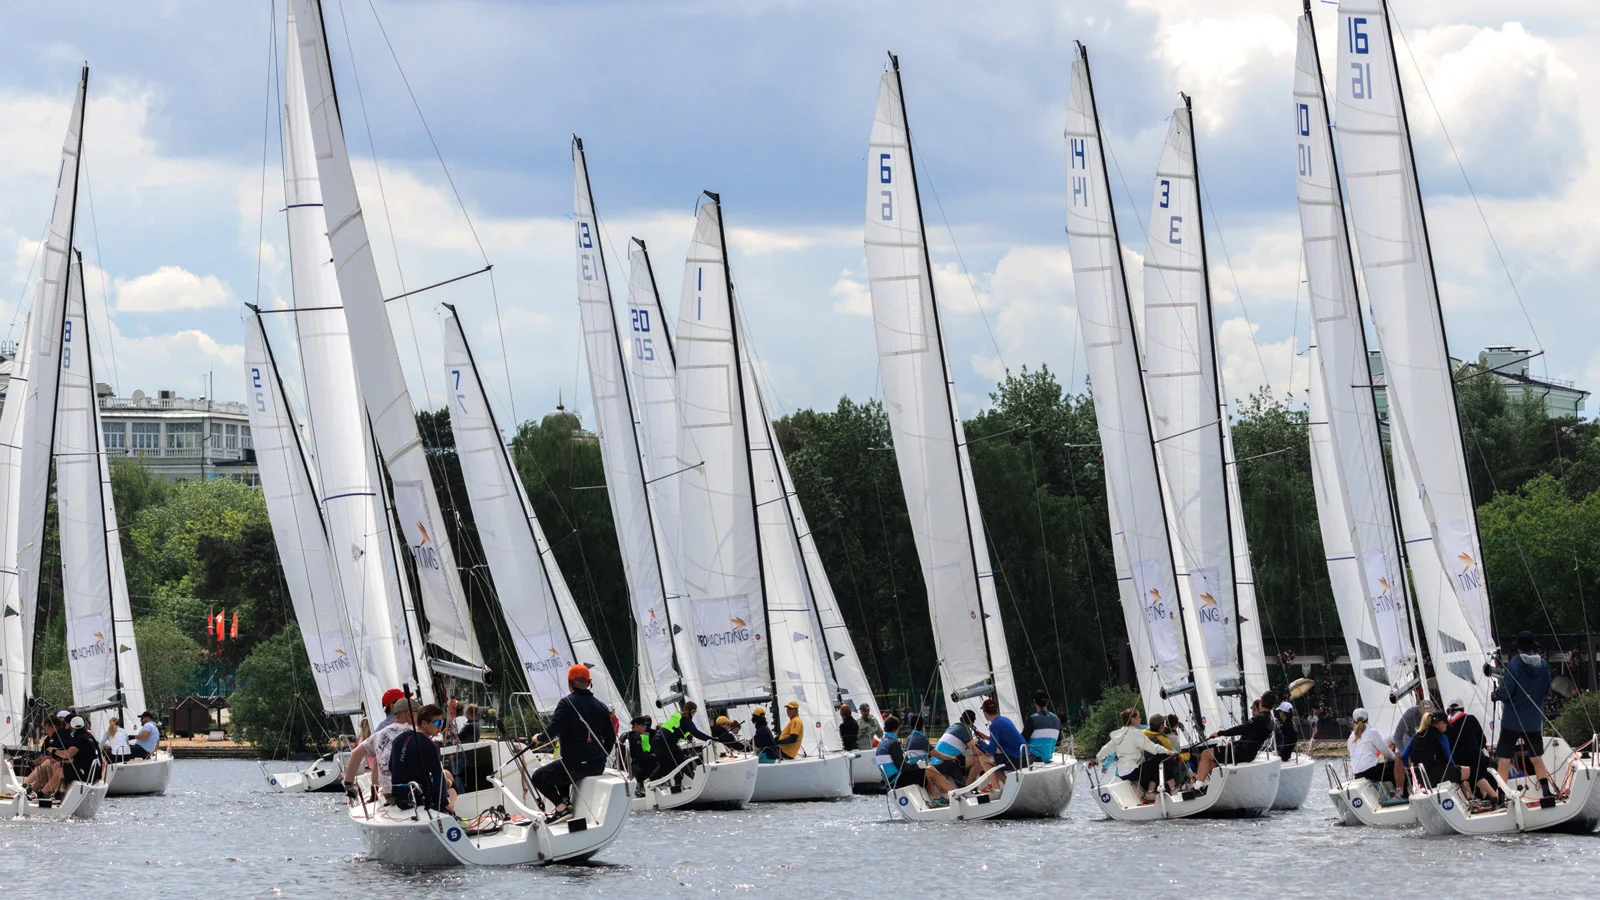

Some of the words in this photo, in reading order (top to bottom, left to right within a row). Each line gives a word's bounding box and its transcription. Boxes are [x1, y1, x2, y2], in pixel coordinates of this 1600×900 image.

[1348, 17, 1369, 54] 16
[1296, 102, 1310, 136] 10
[1070, 138, 1085, 169] 14
[880, 153, 892, 184] 6
[1160, 180, 1170, 208] 3
[577, 221, 593, 249] 13
[64, 320, 72, 343] 8
[631, 309, 651, 332] 20
[251, 368, 262, 388] 2
[451, 370, 460, 390] 7
[1200, 607, 1220, 624] ING
[450, 829, 458, 839] 5
